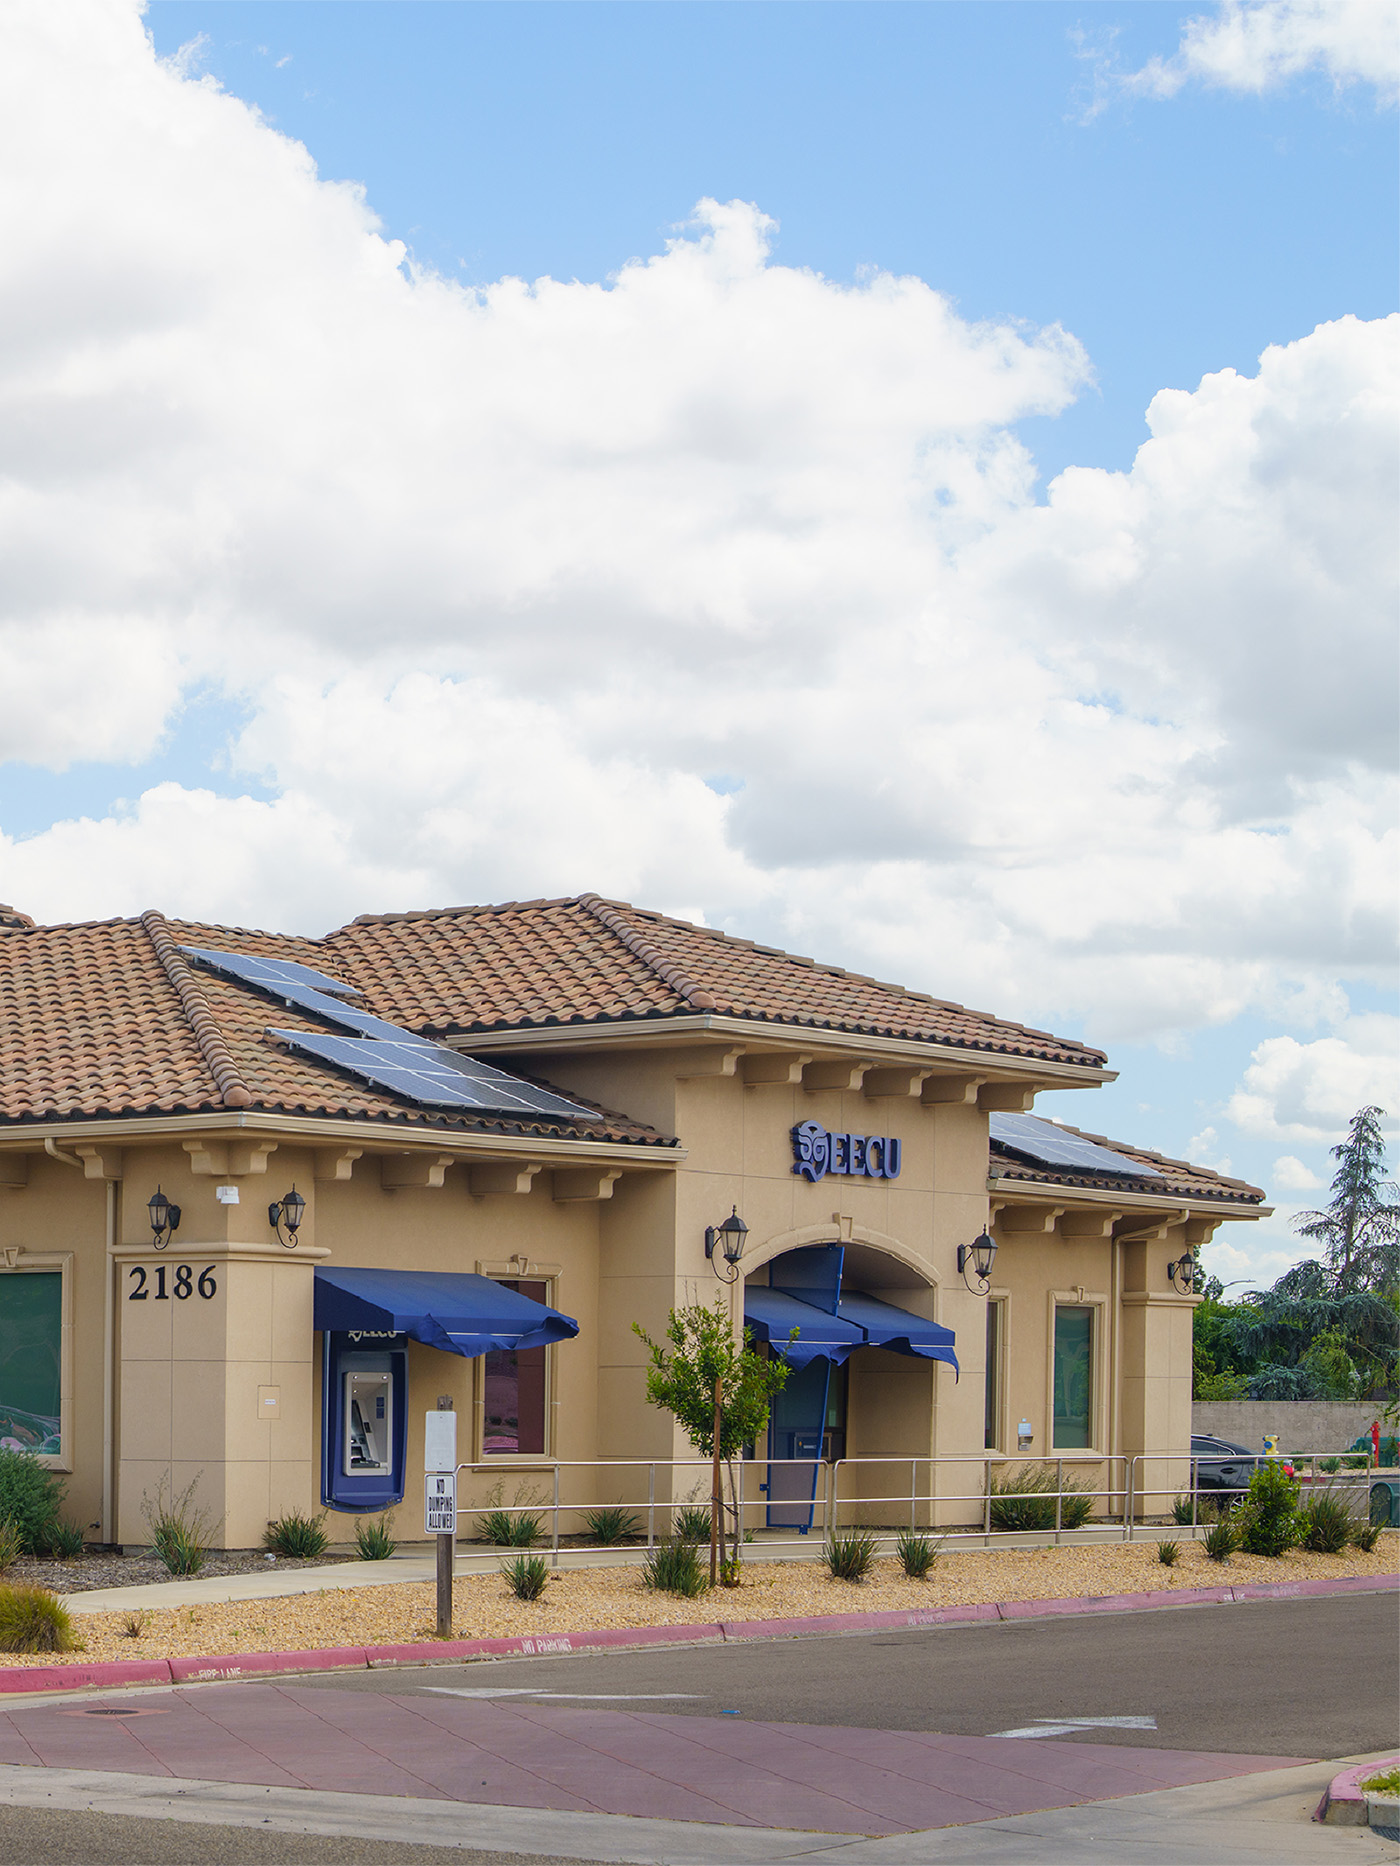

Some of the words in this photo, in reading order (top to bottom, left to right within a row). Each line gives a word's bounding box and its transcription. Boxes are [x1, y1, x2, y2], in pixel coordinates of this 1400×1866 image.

[826, 1132, 902, 1179] EECU
[129, 1265, 217, 1300] 2186
[436, 1478, 445, 1494] NO
[428, 1496, 453, 1512] DUMPING
[428, 1513, 453, 1529] ALLOWED
[521, 1639, 535, 1654] NO
[536, 1638, 572, 1653] PARKING
